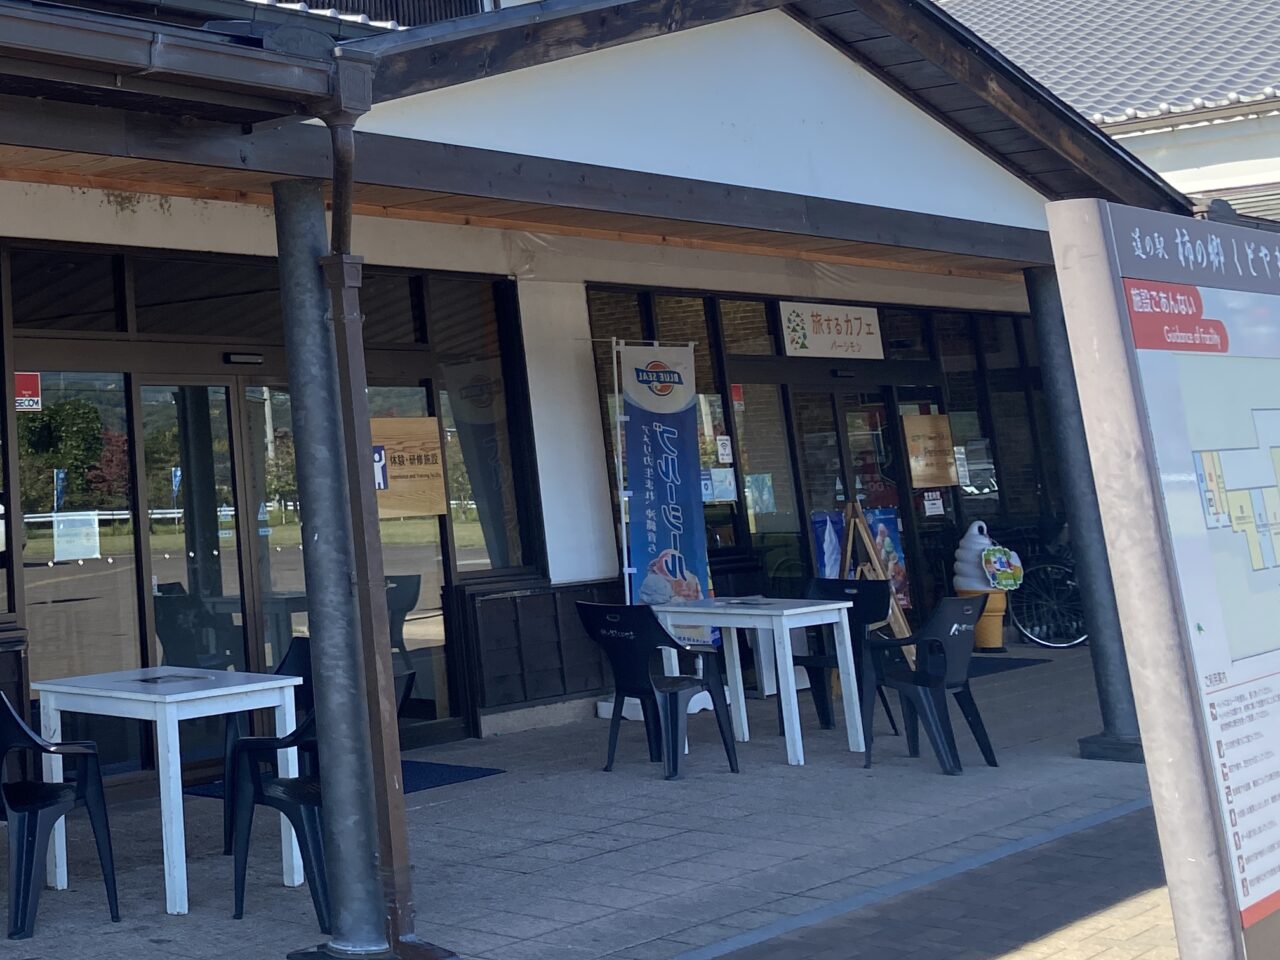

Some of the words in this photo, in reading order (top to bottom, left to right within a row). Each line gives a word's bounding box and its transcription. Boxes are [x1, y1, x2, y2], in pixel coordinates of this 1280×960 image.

[1130, 287, 1197, 315] 施設ごあんない
[810, 311, 875, 337] 旅するカフェ
[15, 398, 40, 408] SECOM
